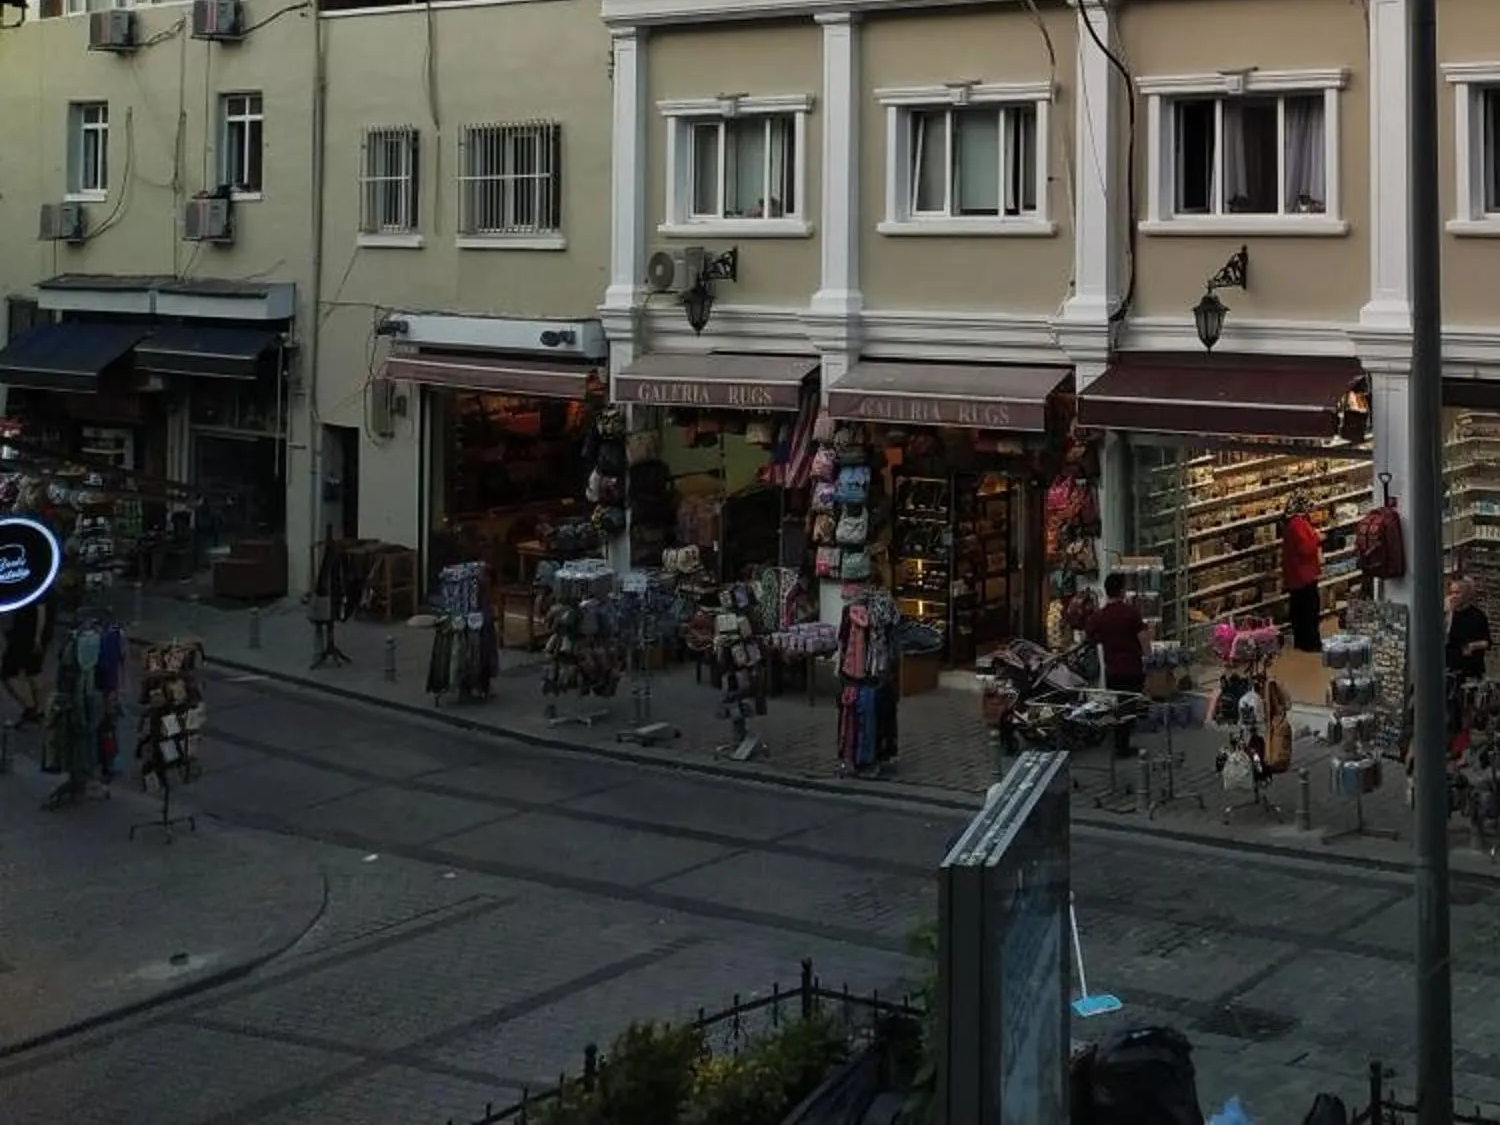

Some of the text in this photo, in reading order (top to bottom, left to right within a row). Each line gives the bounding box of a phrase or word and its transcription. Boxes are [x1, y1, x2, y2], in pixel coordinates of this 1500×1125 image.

[638, 382, 772, 405] GALERIA RUGS
[958, 403, 1010, 425] RUGS
